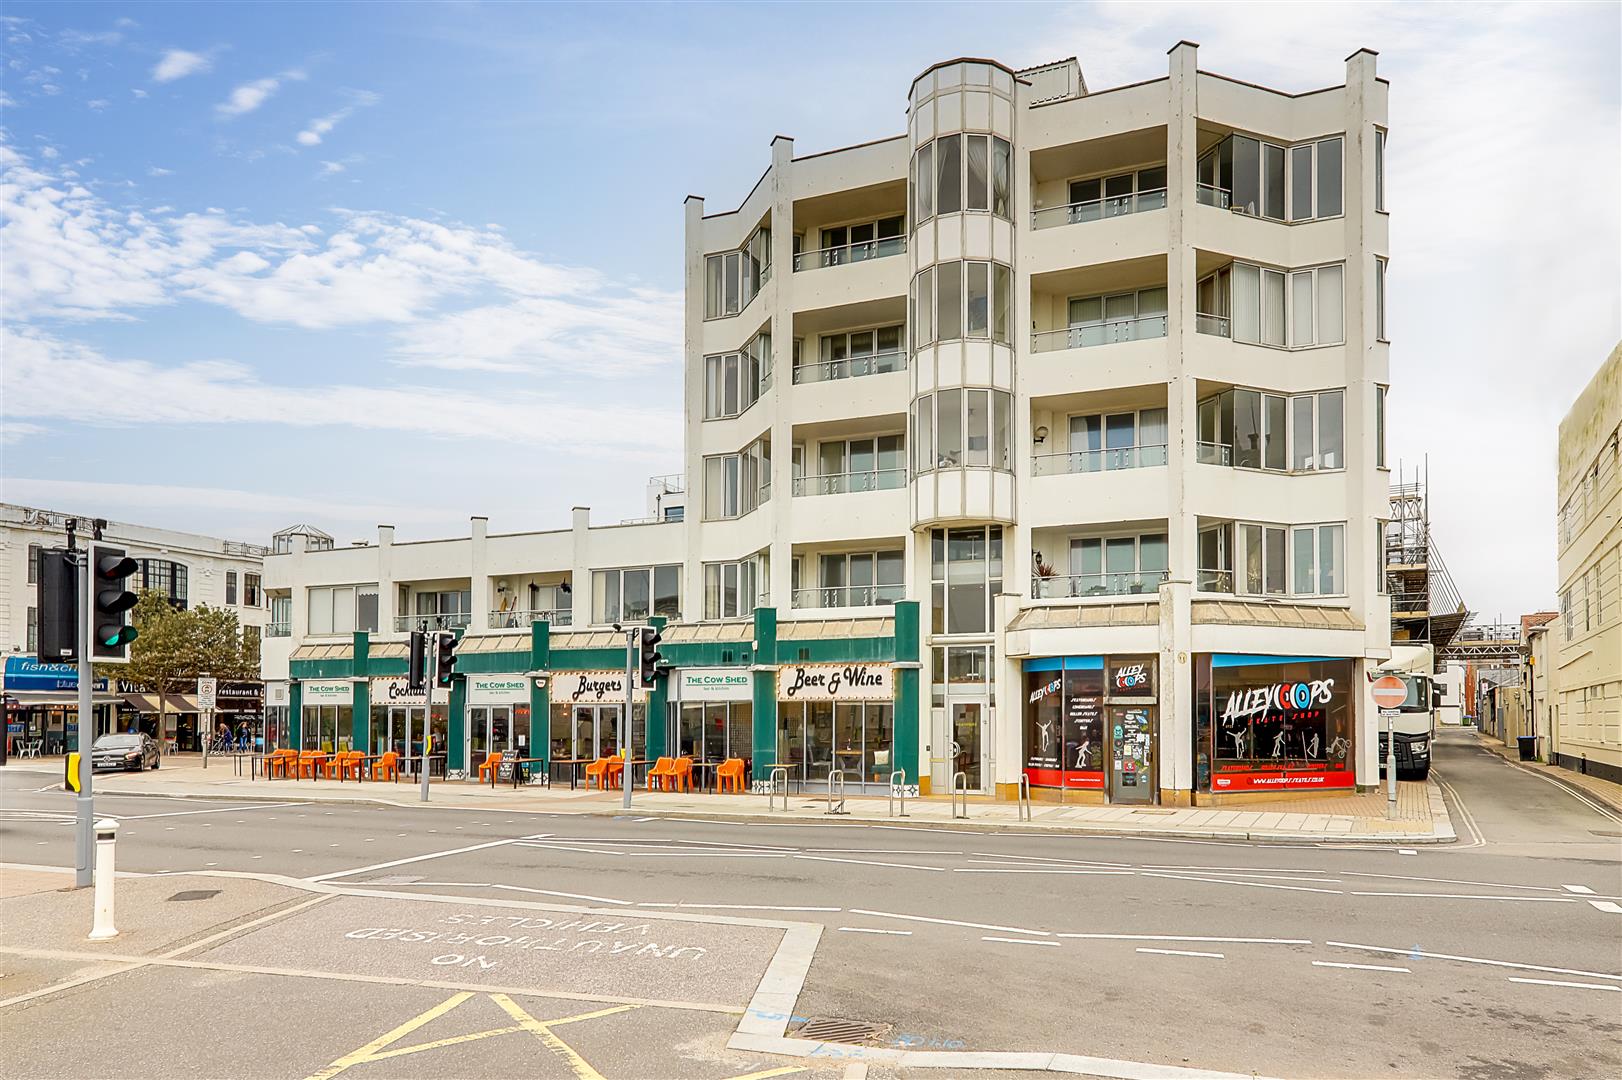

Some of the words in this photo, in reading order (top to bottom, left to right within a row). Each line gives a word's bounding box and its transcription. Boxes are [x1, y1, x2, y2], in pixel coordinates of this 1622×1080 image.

[686, 676, 703, 684] THE
[704, 676, 724, 684] COW
[725, 676, 748, 684] SHED
[787, 667, 826, 696] Beer
[827, 672, 842, 694] &
[843, 666, 883, 687] Wine
[1115, 663, 1145, 680] ALLEY
[572, 676, 622, 700] Burgers
[1291, 710, 1320, 720] SHOP
[438, 912, 651, 936] VEHICLES
[344, 927, 707, 961] UNAUTHORISED
[430, 953, 498, 970] NO
